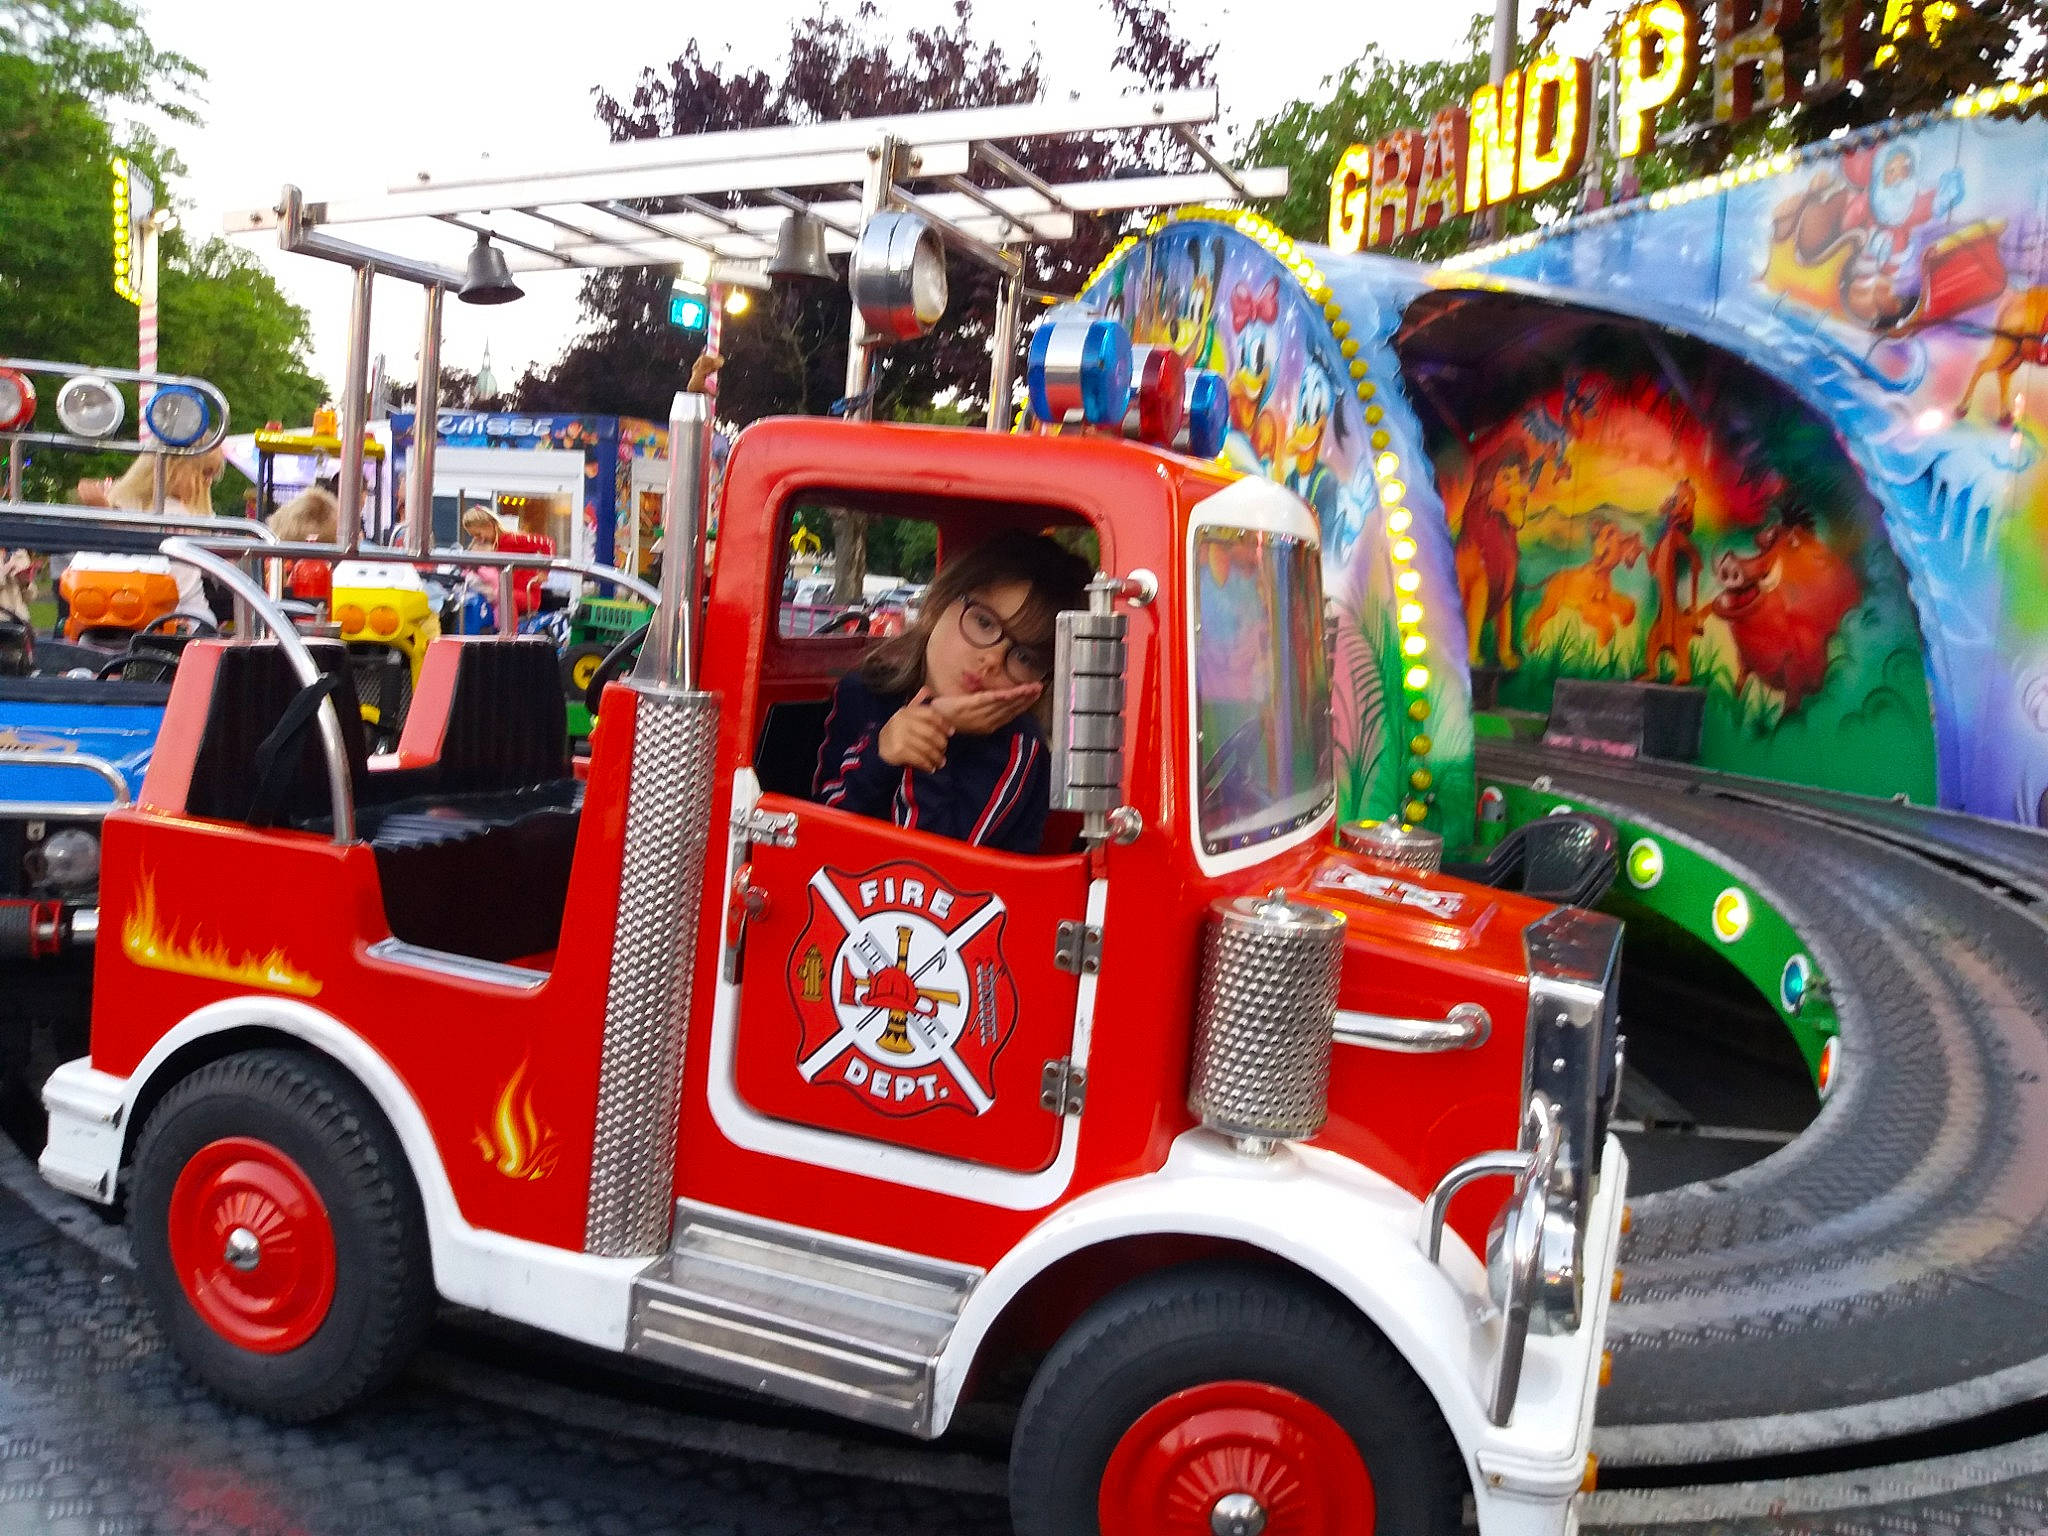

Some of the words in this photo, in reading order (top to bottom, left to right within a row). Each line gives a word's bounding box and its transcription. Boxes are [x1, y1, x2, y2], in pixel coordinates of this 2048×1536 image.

[1328, 53, 1590, 253] GRAND
[859, 877, 954, 920] FIRE
[844, 1057, 949, 1102] DEPT.
